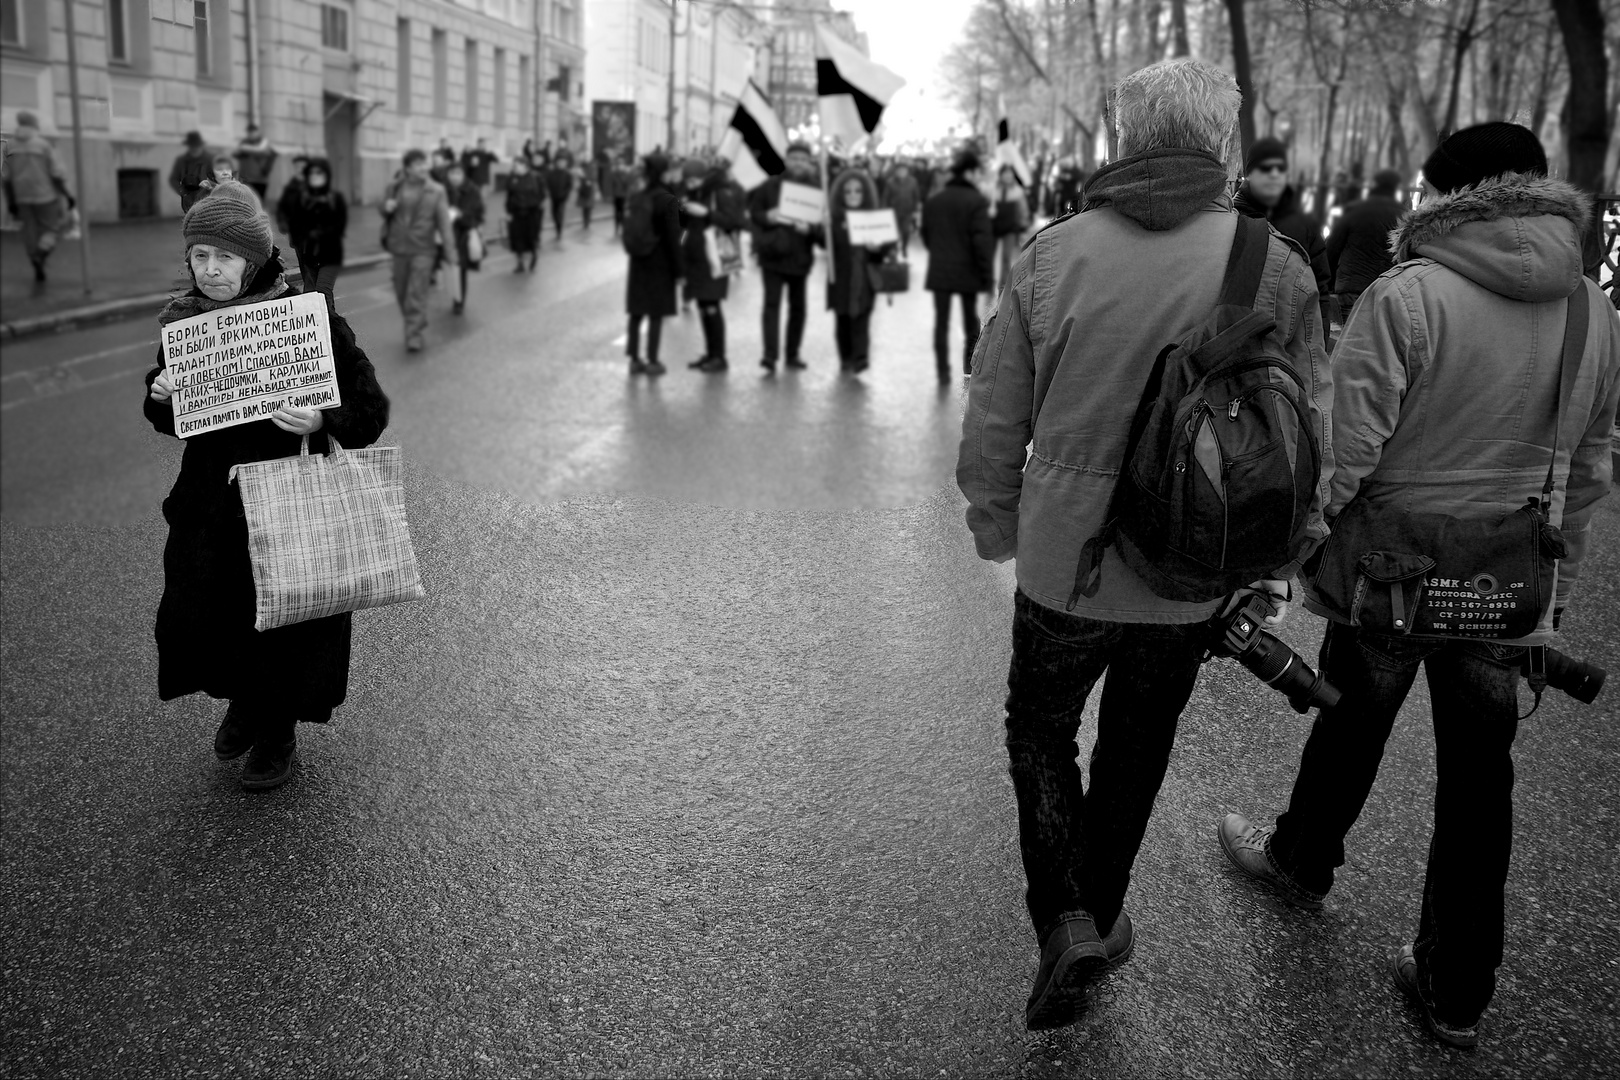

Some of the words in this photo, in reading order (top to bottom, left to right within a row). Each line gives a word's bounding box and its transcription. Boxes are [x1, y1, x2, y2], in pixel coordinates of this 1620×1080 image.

[167, 322, 208, 344] БОРИС
[216, 299, 294, 330] ЕФИМОВИЧ!
[169, 344, 183, 359] ВЫ
[186, 335, 216, 354] БЫЛИ
[256, 330, 317, 352] КРАСИВЫМ
[175, 358, 243, 388] ЧЕЛОВЕКОМ!
[294, 342, 324, 362] ВАМ!
[269, 360, 320, 380] КАРЛИКИ
[179, 404, 186, 415] И
[188, 391, 234, 411] ВАМПИРЫ
[1423, 578, 1460, 588] ASMK
[1428, 600, 1517, 609] 1234-567-8958
[1433, 622, 1452, 630] WM.
